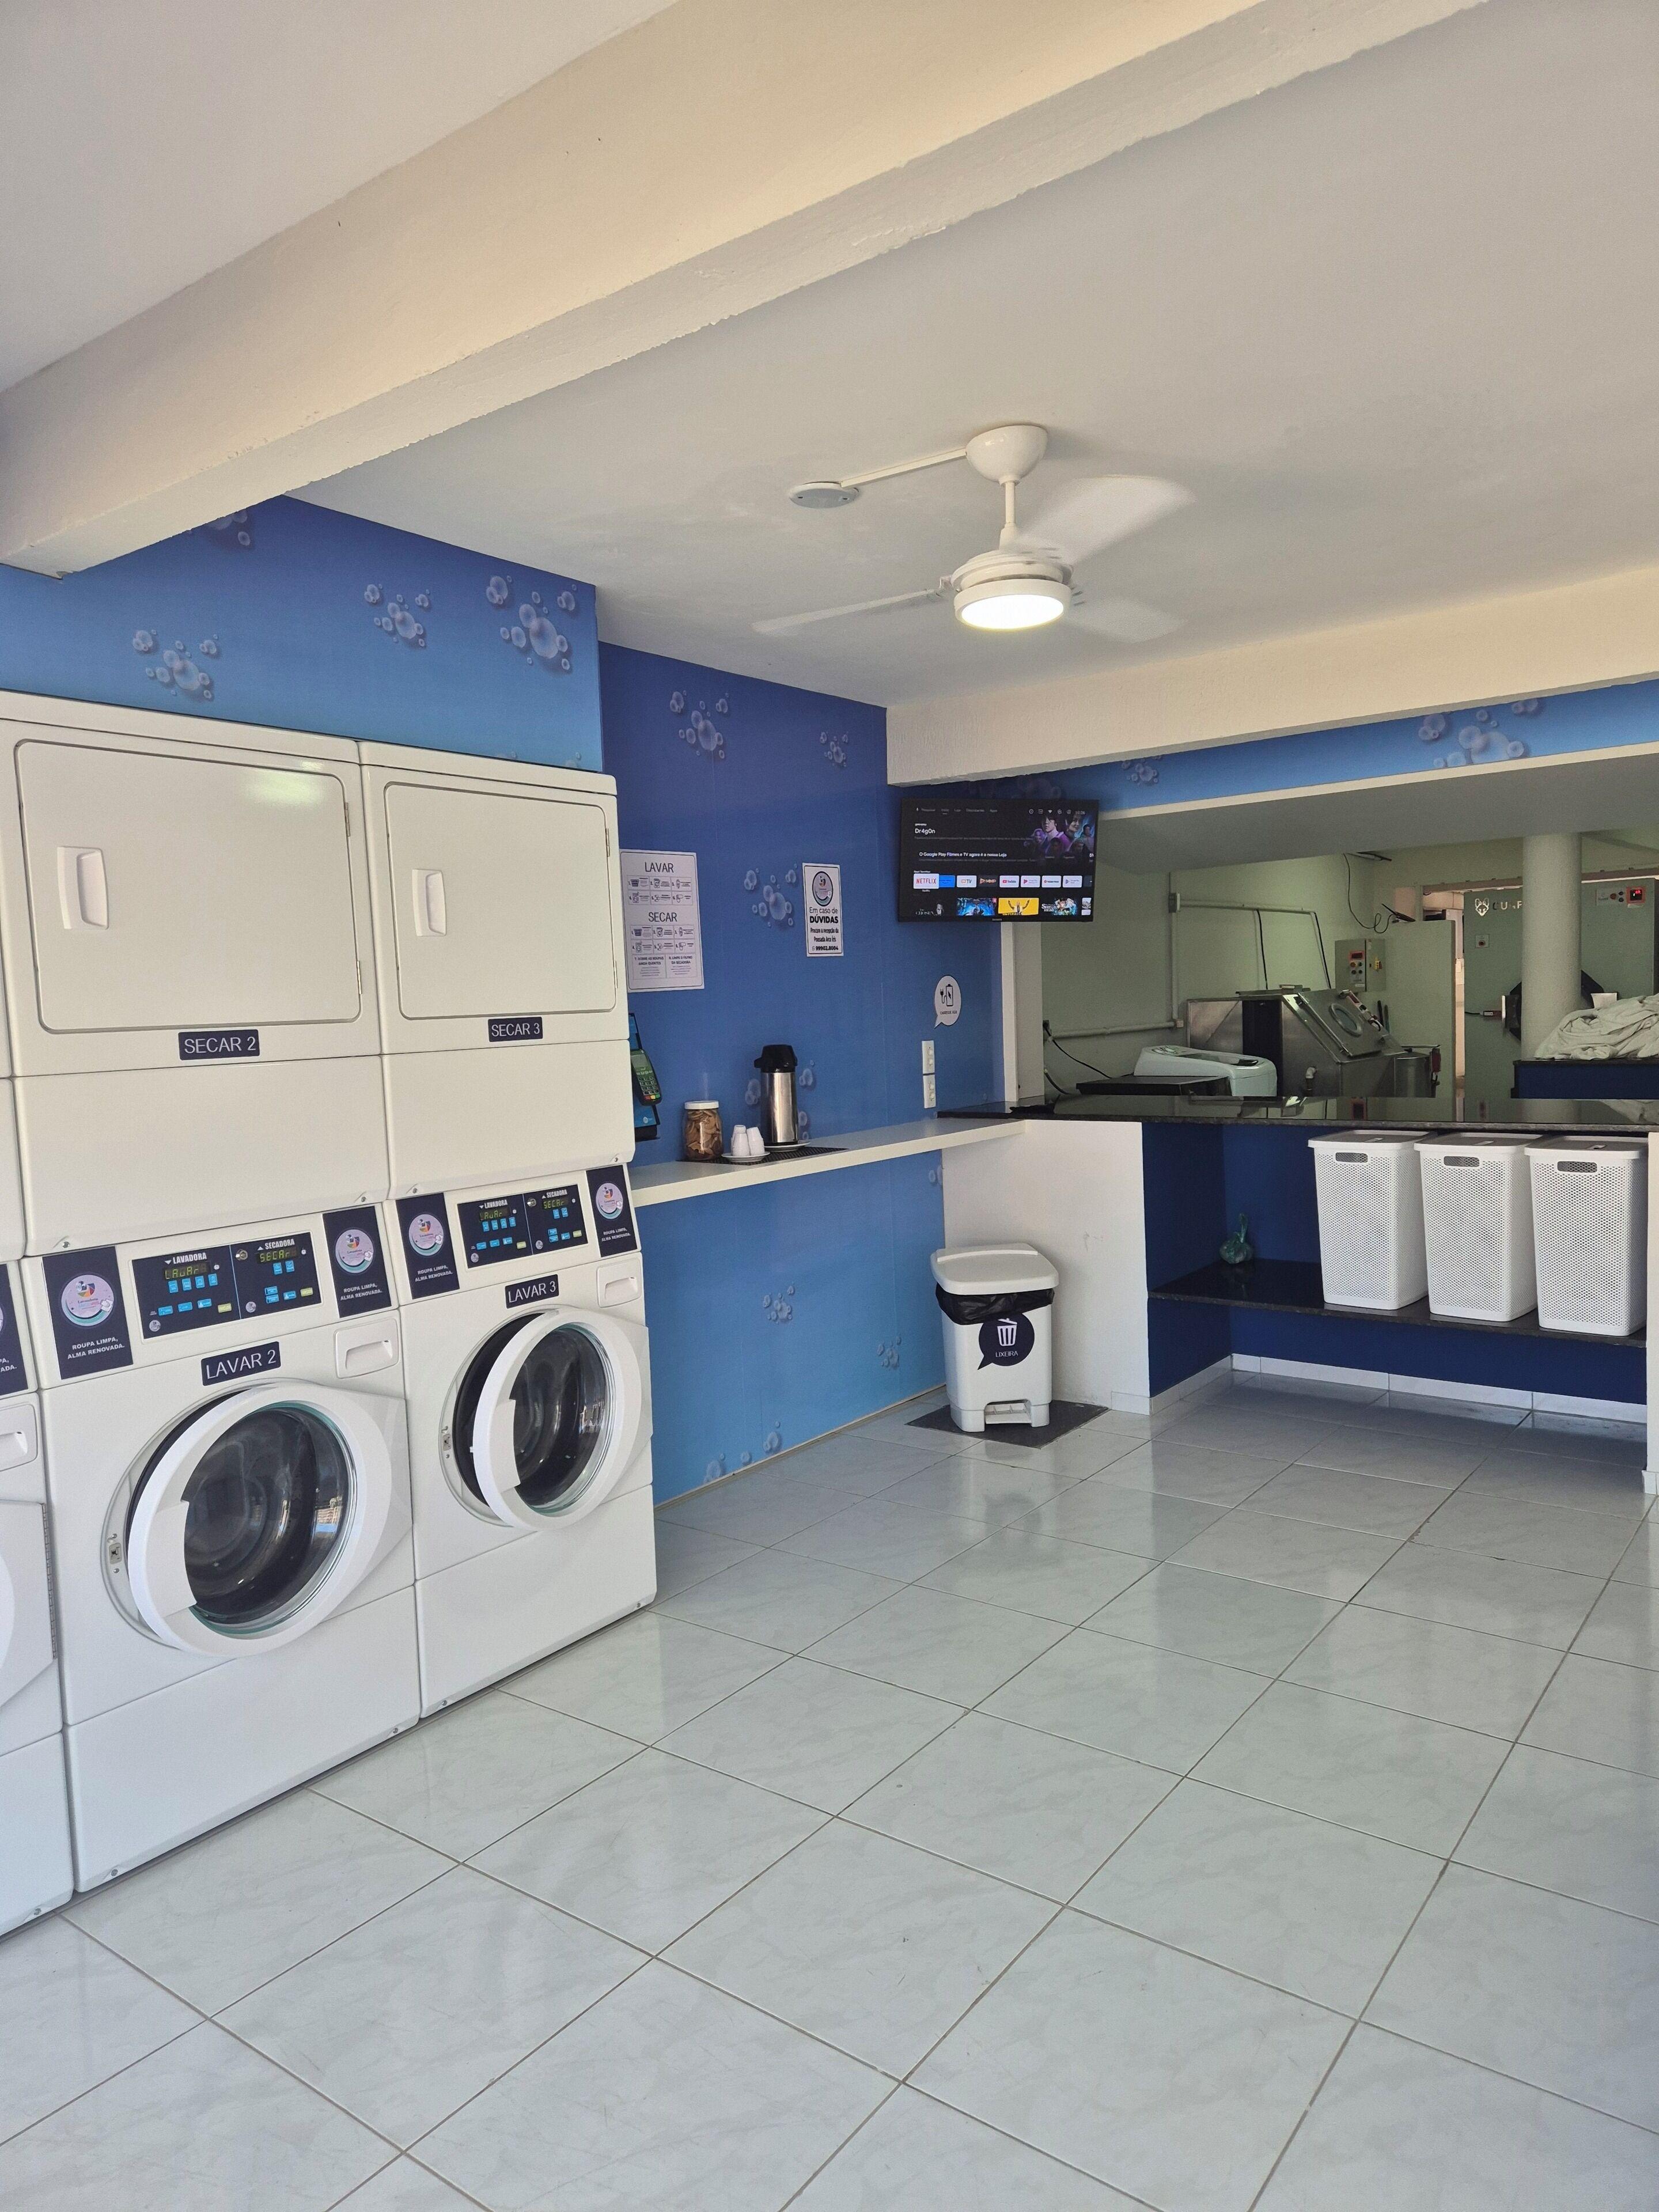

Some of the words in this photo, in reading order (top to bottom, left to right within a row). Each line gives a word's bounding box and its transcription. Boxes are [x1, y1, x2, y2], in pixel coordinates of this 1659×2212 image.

[645, 862, 674, 873] LAVAR
[649, 912, 677, 922] SECAR
[810, 914, 838, 923] DÚVIDAS
[491, 1023, 529, 1037] SECAR
[532, 1022, 540, 1035] 3
[184, 1037, 243, 1054] SECAR
[247, 1036, 256, 1051] 2
[546, 1189, 568, 1198] SECADORA
[484, 1199, 507, 1209] LAVADORA
[264, 1238, 295, 1250] SECADORA
[173, 1252, 207, 1264] LAVADORA
[343, 1285, 361, 1293] ROUPA
[355, 1289, 382, 1298] RENOVADA.
[507, 1285, 547, 1304] LAVAR
[549, 1283, 556, 1294] 3
[72, 1342, 94, 1350] ROUPA
[96, 1337, 118, 1345] LIMPA,
[67, 1351, 86, 1360] ALMA
[88, 1343, 126, 1355] RENOVADA.
[206, 1352, 263, 1380] LAVAR
[266, 1349, 277, 1365] 2
